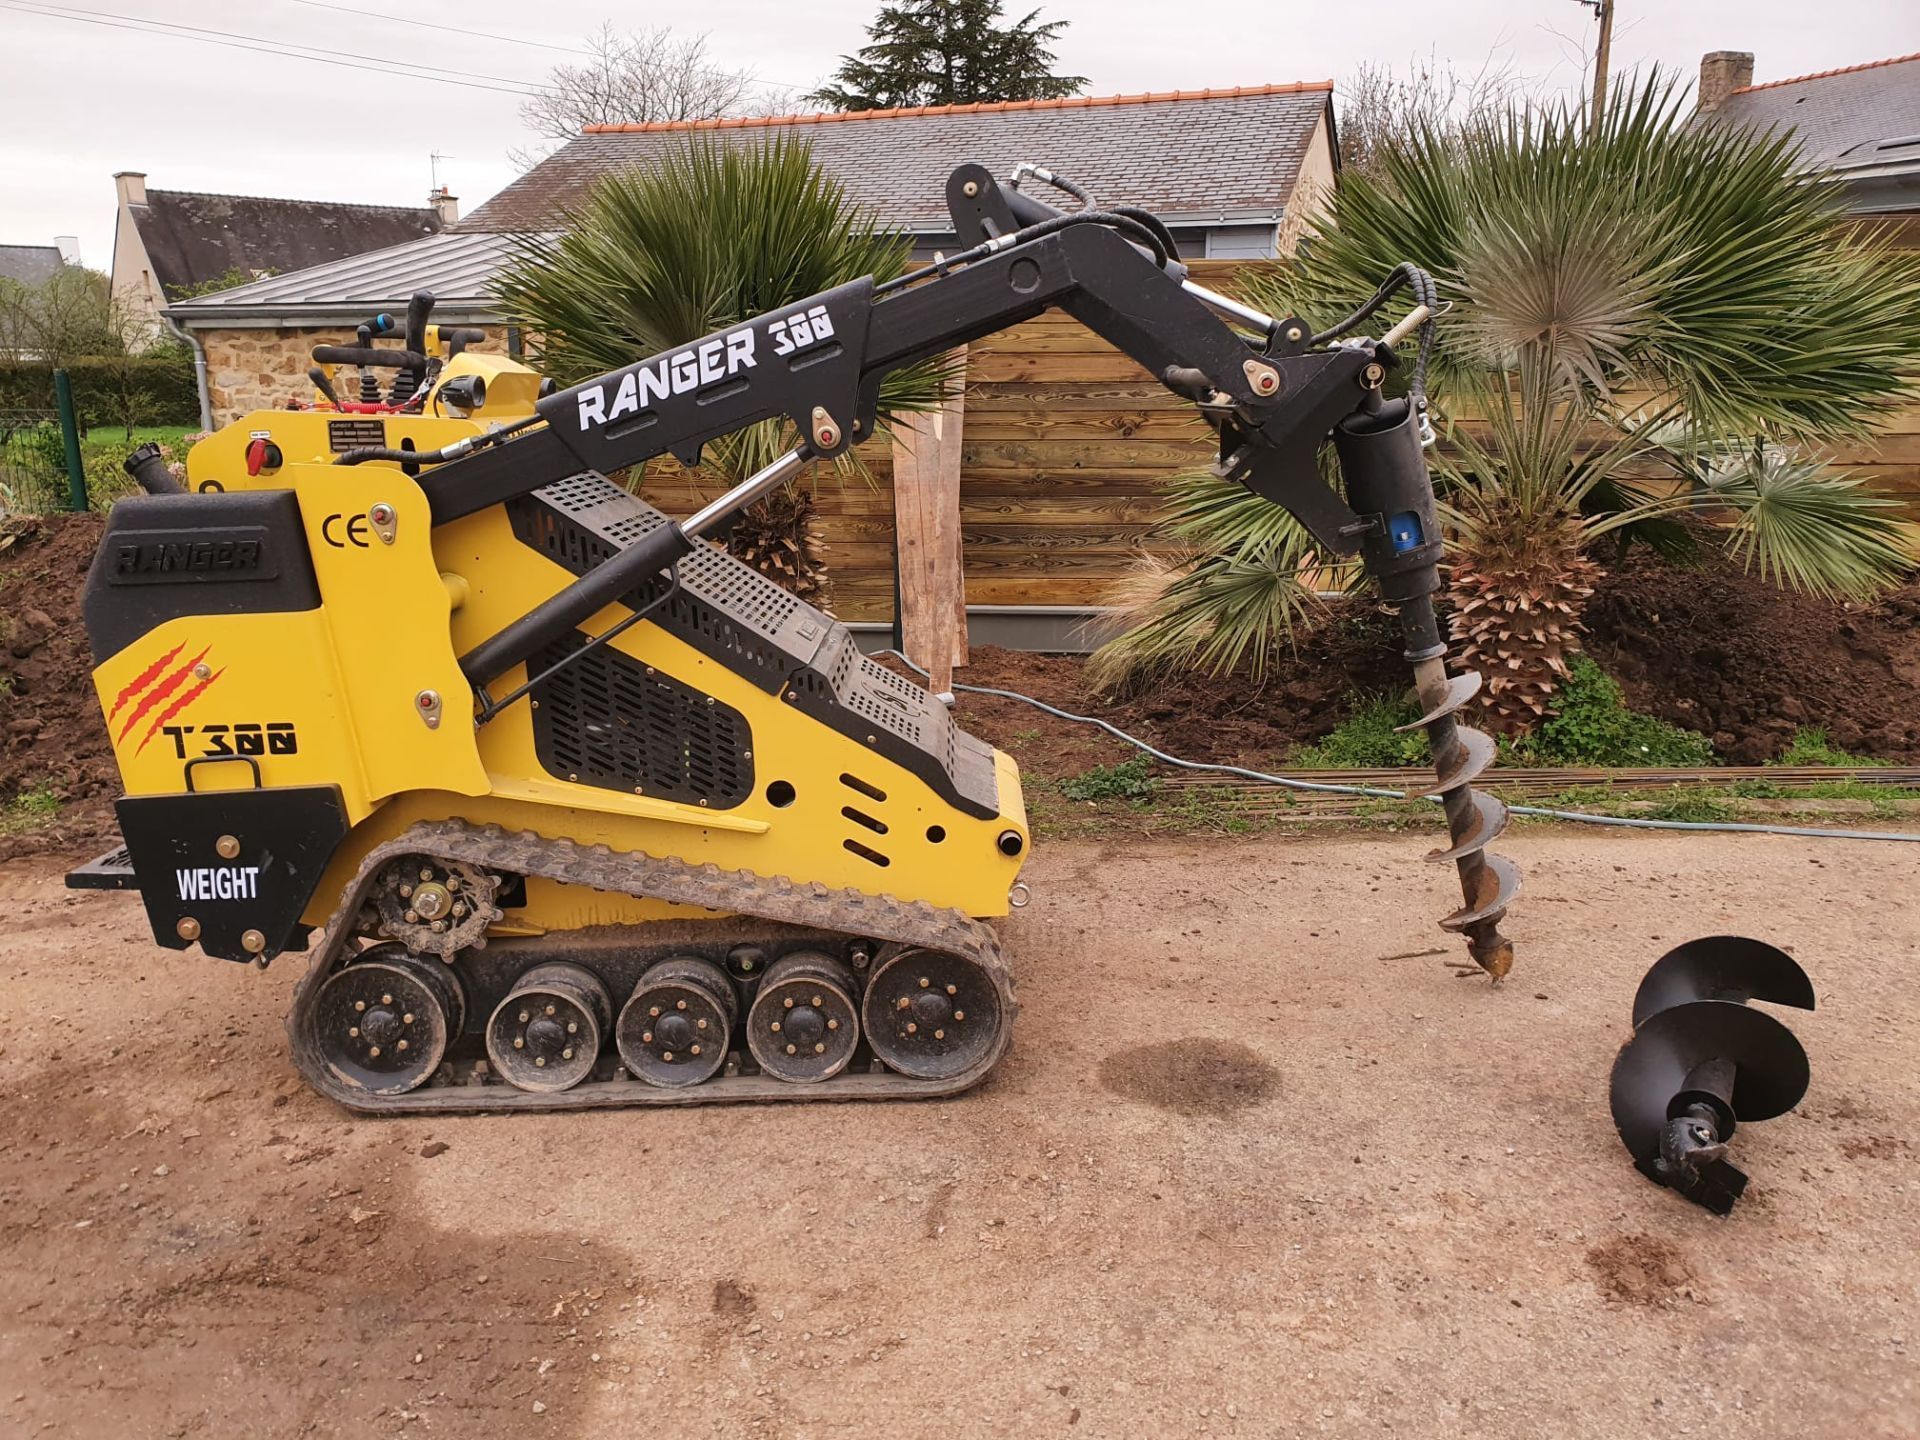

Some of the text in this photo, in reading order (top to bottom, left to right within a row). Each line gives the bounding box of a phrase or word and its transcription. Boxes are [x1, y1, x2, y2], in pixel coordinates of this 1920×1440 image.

[577, 305, 835, 431] RANGER 300
[322, 513, 369, 548] CE
[116, 540, 262, 574] RANGER
[162, 722, 298, 759] T300
[176, 866, 259, 901] WEIGHT
